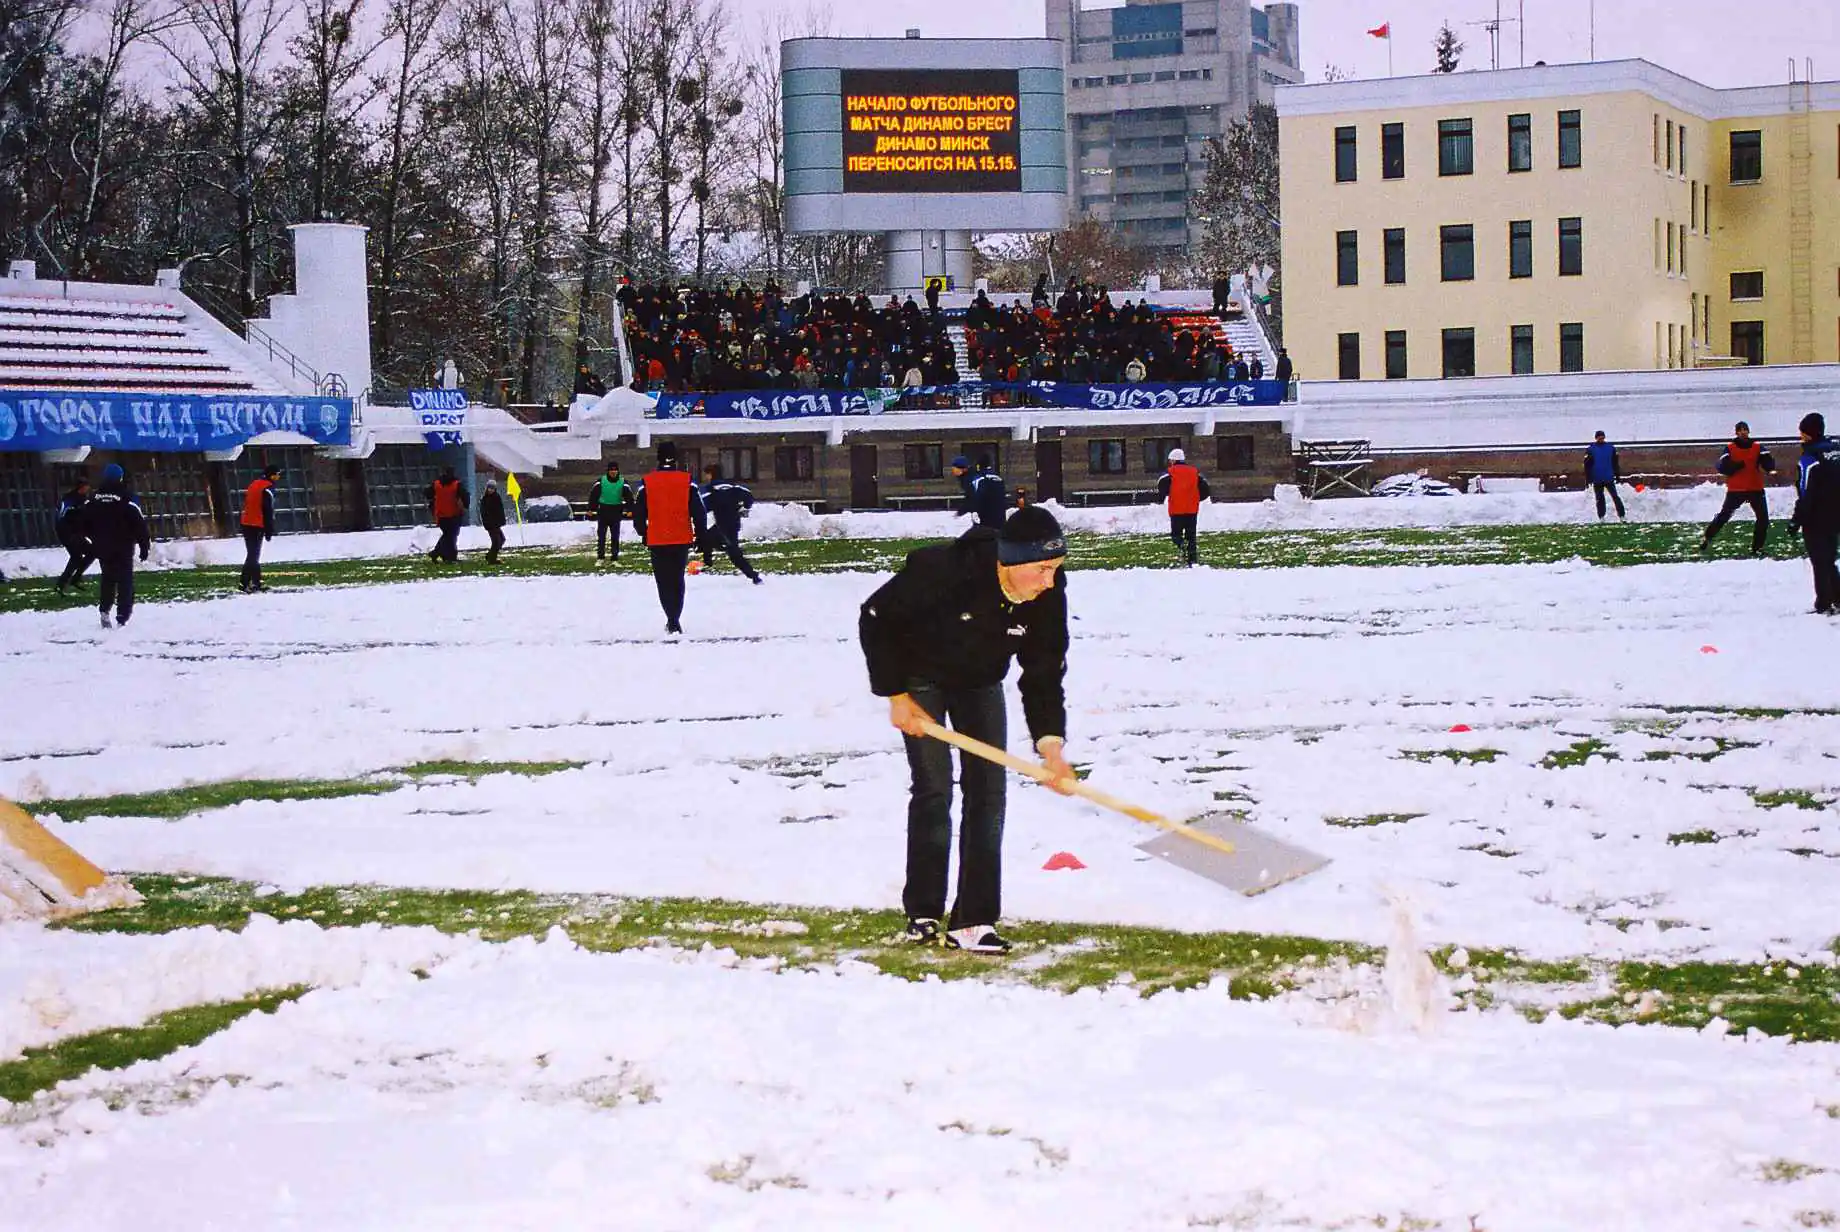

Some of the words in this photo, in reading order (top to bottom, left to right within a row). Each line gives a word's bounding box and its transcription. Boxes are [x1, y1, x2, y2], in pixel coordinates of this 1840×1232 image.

[847, 96, 907, 111] НАЧАЛО
[910, 96, 1015, 111] ФУТБОЛЬНОГО
[851, 116, 899, 131] МАТЧА
[903, 116, 964, 132] ДИНАМО
[967, 116, 1012, 131] БРЕСТ
[876, 137, 937, 152] ДИНАМО
[940, 137, 989, 150] МИНСК
[848, 157, 952, 171] ПЕРЕНОСИТСЯ
[956, 157, 977, 170] НА
[979, 157, 1017, 170] 15.15.
[19, 398, 122, 444] ГОРОД
[130, 401, 199, 446] НАД
